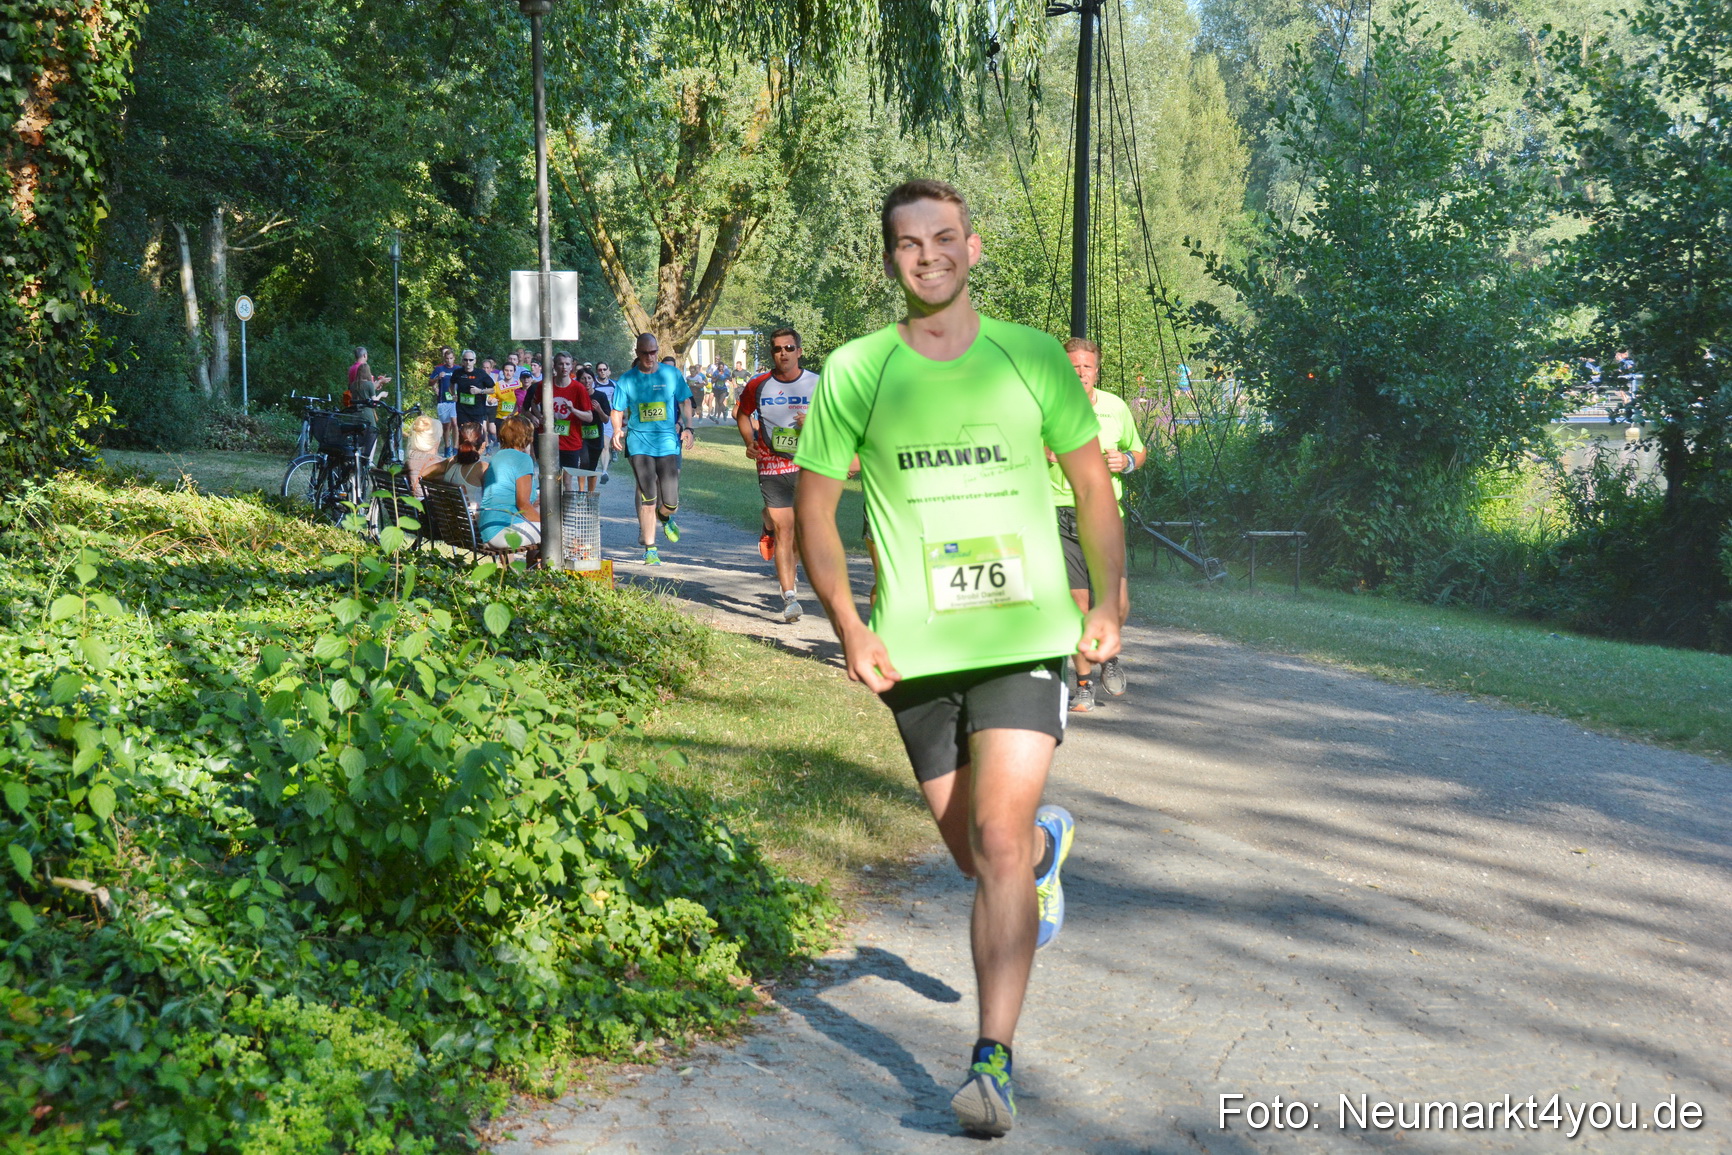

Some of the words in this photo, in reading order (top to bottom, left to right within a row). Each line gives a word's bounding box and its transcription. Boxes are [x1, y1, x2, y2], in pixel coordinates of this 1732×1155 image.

[642, 408, 663, 417] 1522
[776, 435, 798, 446] 1751
[897, 444, 1007, 470] BRANDL
[949, 562, 1006, 592] 476
